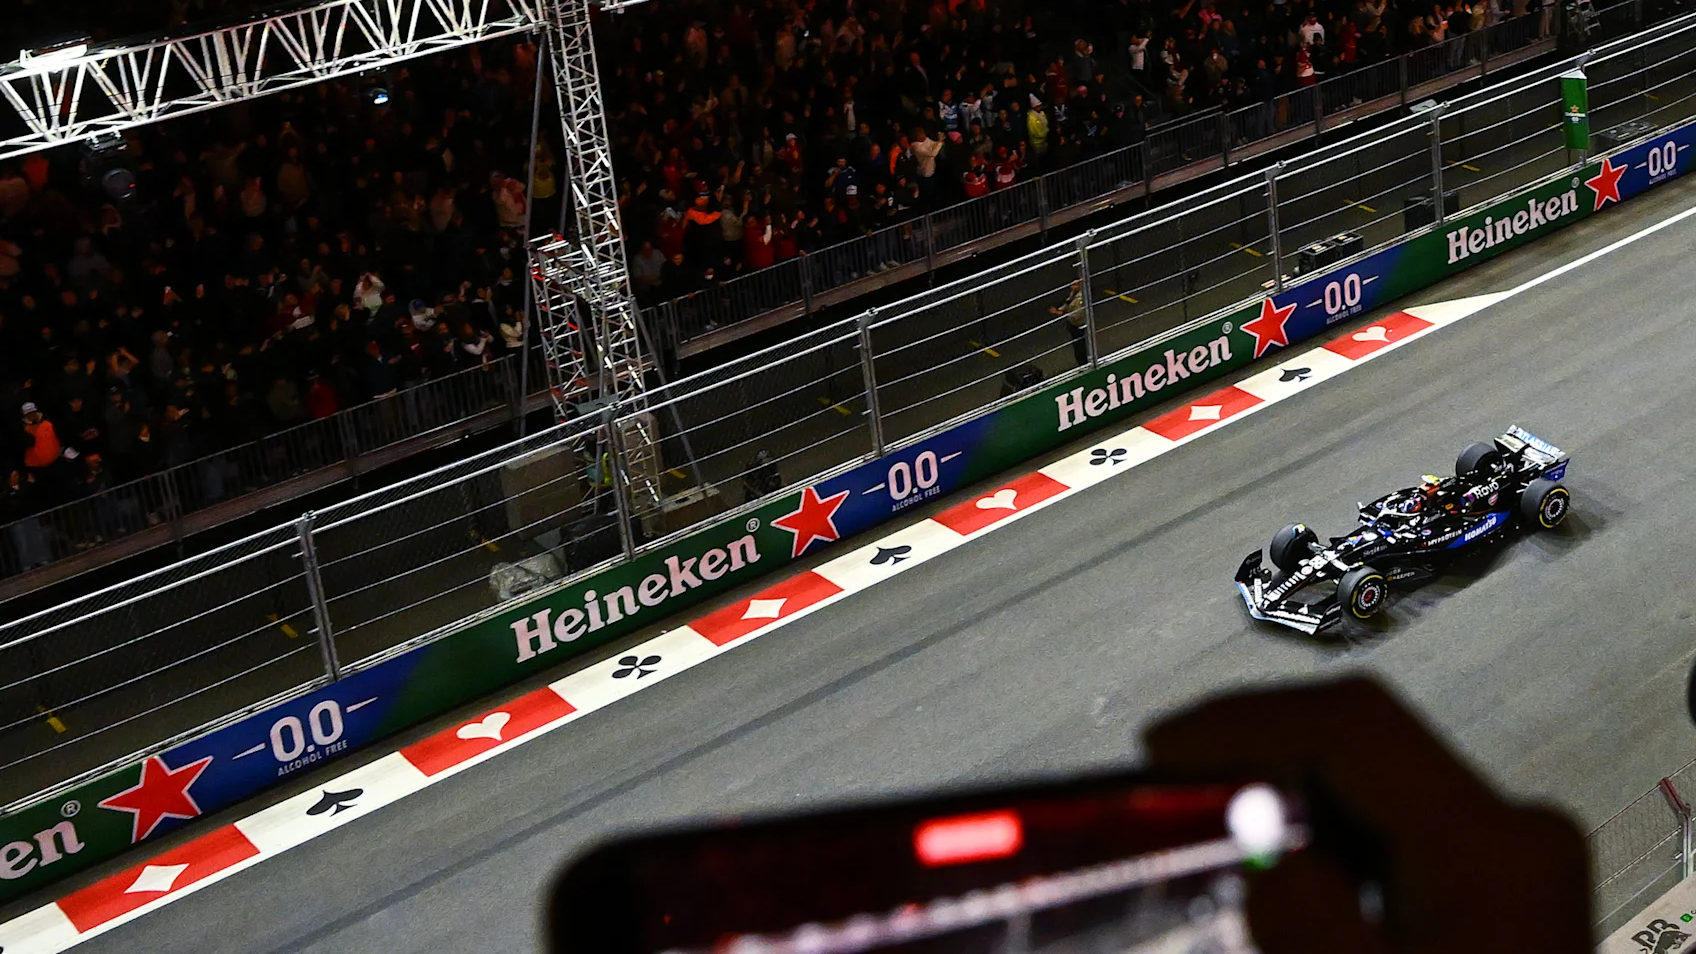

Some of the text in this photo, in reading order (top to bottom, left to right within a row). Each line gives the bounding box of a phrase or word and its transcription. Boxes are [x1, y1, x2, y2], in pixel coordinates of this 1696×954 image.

[1447, 140, 1676, 265] Heineken 0.0
[1056, 272, 1362, 432] Heineken 0.0
[892, 485, 941, 514] ALCOHOL FREE
[1474, 481, 1500, 500] Rovo
[1464, 516, 1498, 542] KOMATSU
[510, 449, 940, 665] Heineken 0.0
[270, 699, 344, 764] 0.0
[278, 739, 348, 776] ALCOHOL FREE
